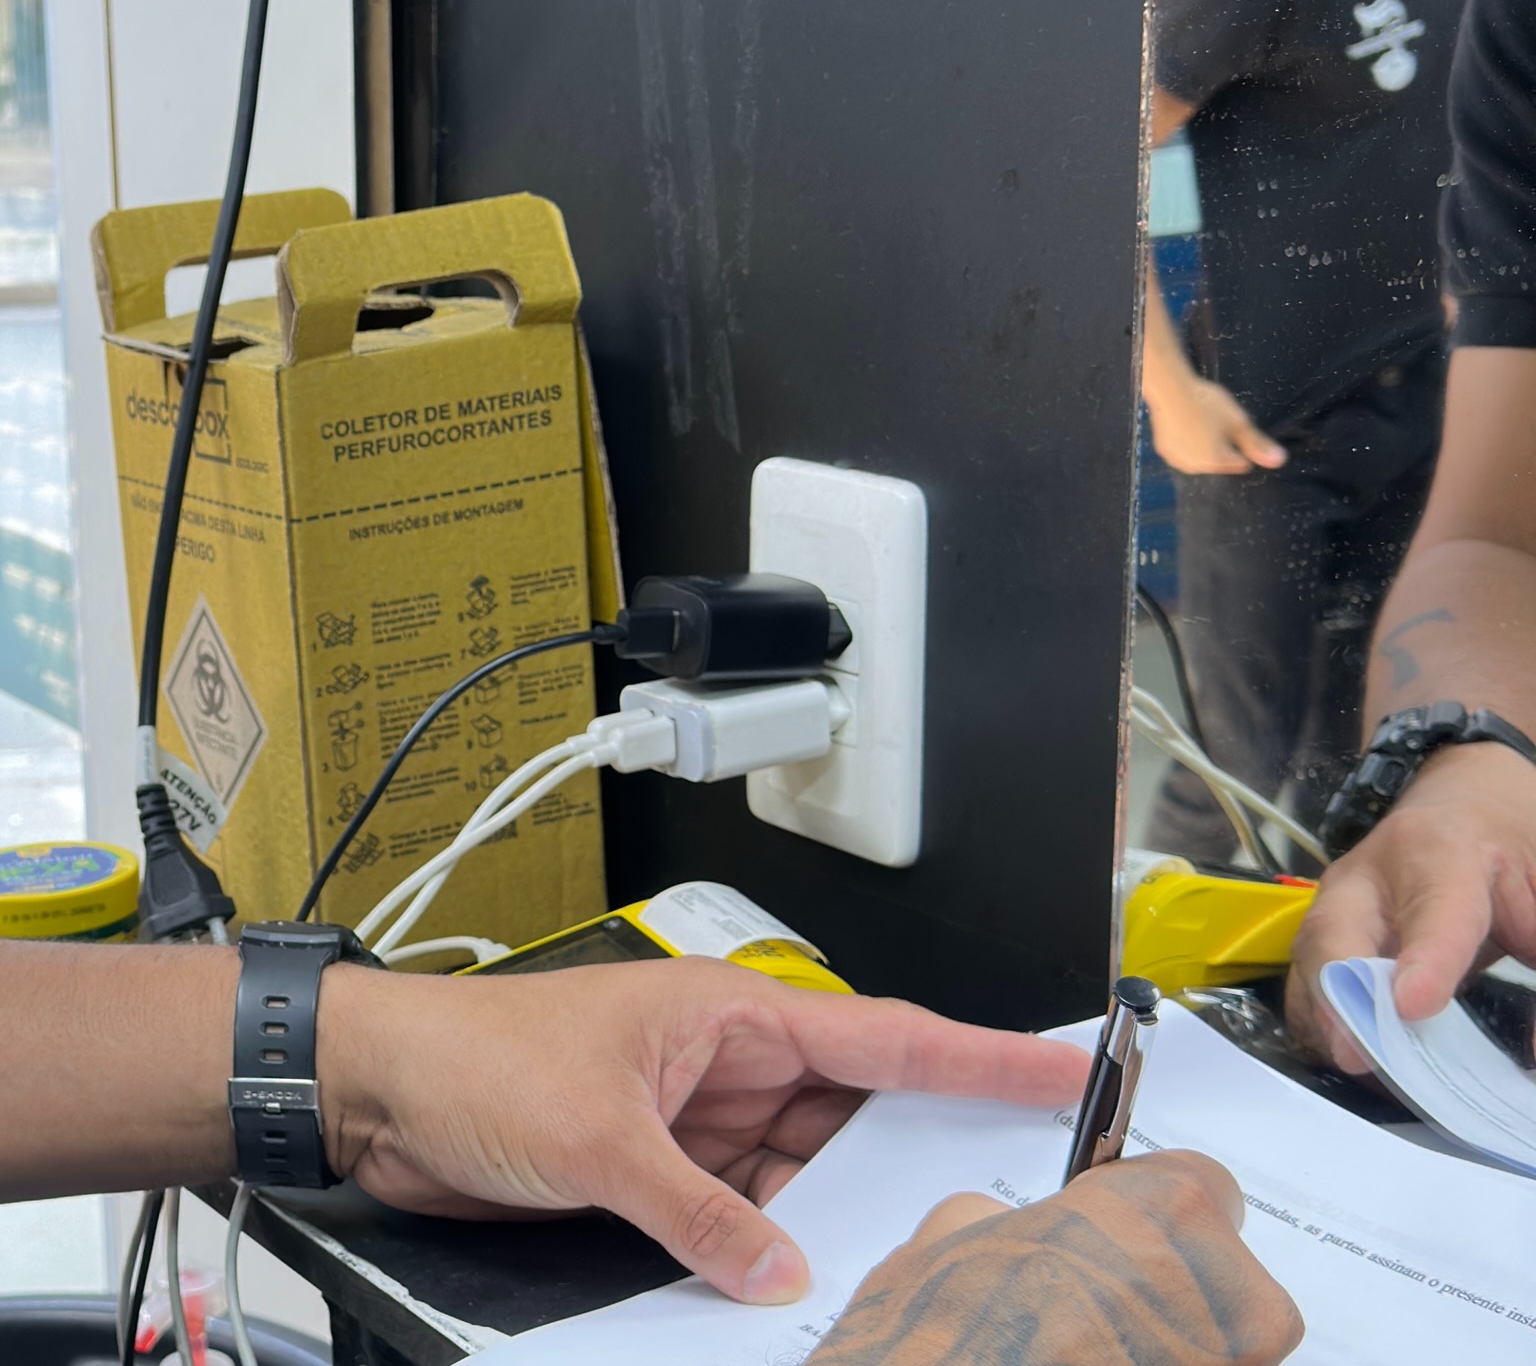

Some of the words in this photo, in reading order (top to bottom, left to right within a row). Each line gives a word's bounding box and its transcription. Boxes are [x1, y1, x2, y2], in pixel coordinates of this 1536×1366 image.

[321, 410, 418, 440] COLETOR
[424, 403, 451, 423] DE
[457, 384, 562, 418] MATERIAIS
[334, 409, 553, 462] PERFUROCORTANTES
[349, 515, 429, 541] INSTRUÇÕES
[433, 512, 450, 526] DE
[454, 498, 525, 522] MONTAGEM
[160, 768, 218, 825] ATENÇÃO
[990, 1178, 1015, 1199] Rio
[1243, 1191, 1300, 1228] tratadas,
[1304, 1223, 1323, 1236] as
[1320, 1232, 1367, 1257] partes
[1367, 1252, 1426, 1282] assinam
[1428, 1277, 1440, 1288] o
[1437, 1284, 1505, 1314] presente
